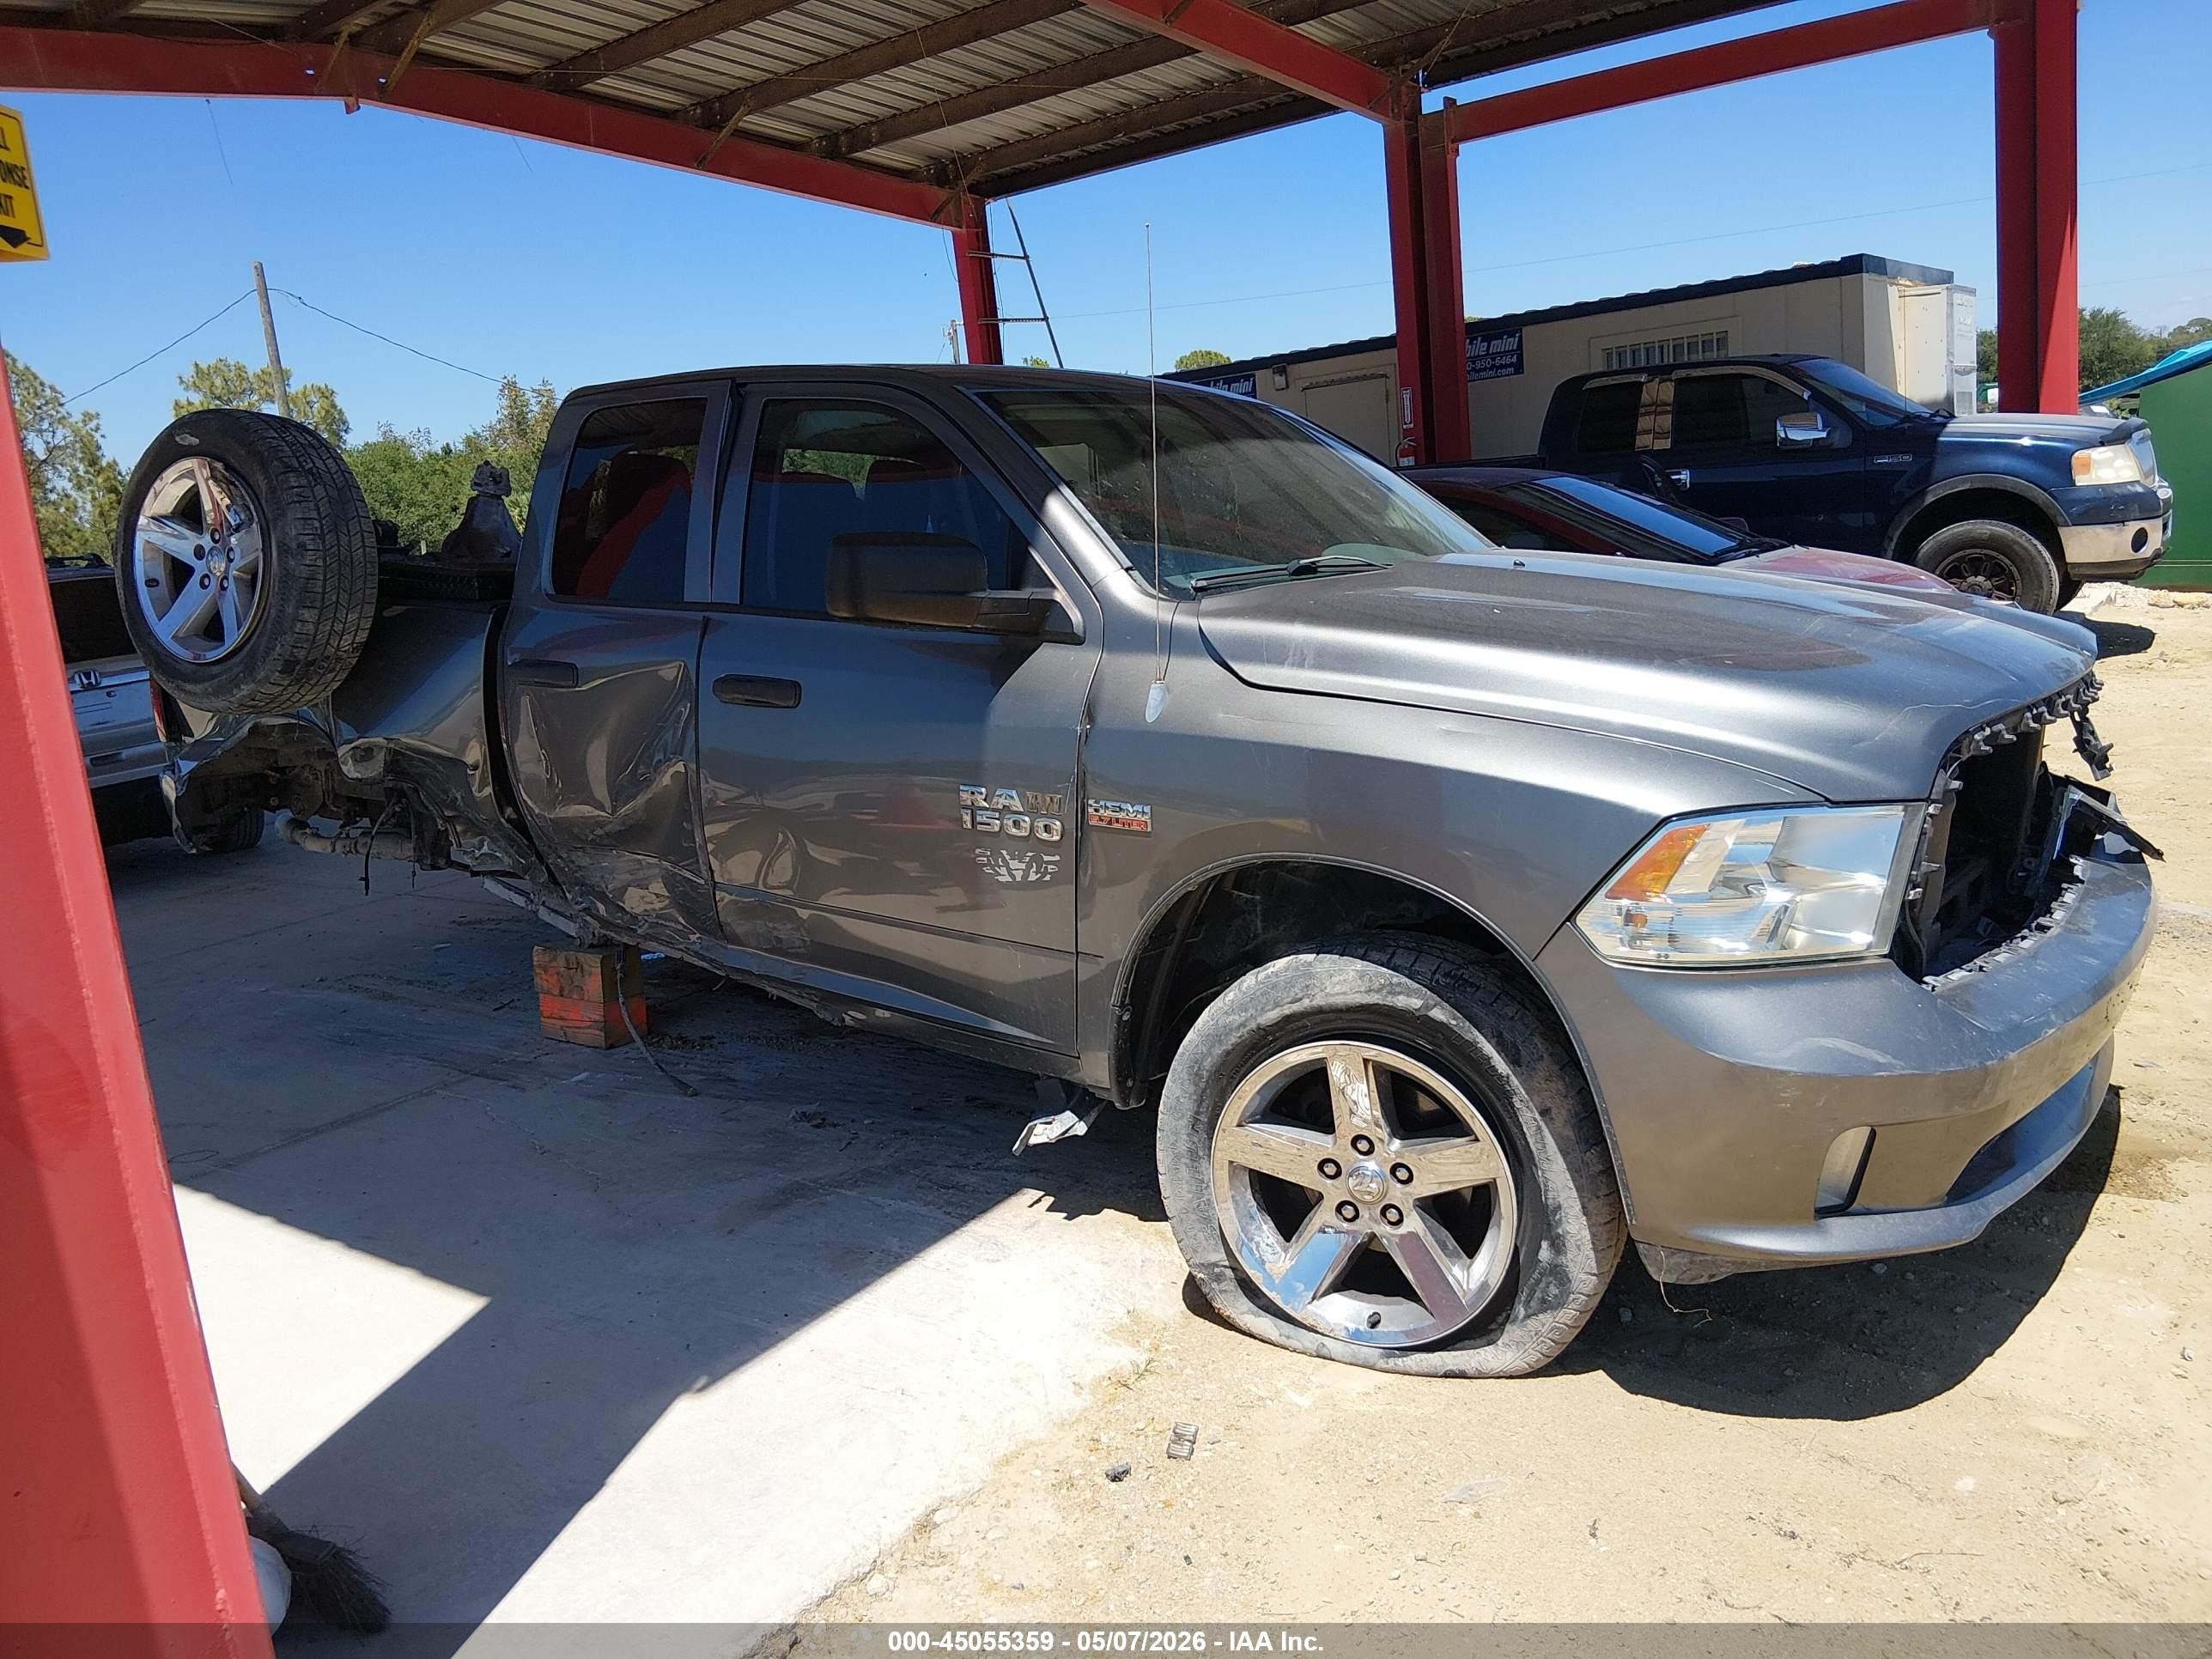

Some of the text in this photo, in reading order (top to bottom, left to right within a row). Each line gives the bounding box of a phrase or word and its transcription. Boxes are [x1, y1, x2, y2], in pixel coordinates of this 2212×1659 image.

[1489, 333, 1519, 354] mini
[959, 784, 1064, 816] RAM
[1088, 799, 1152, 819] HEMI
[961, 807, 1063, 842] 1500
[1111, 817, 1148, 830] LITER
